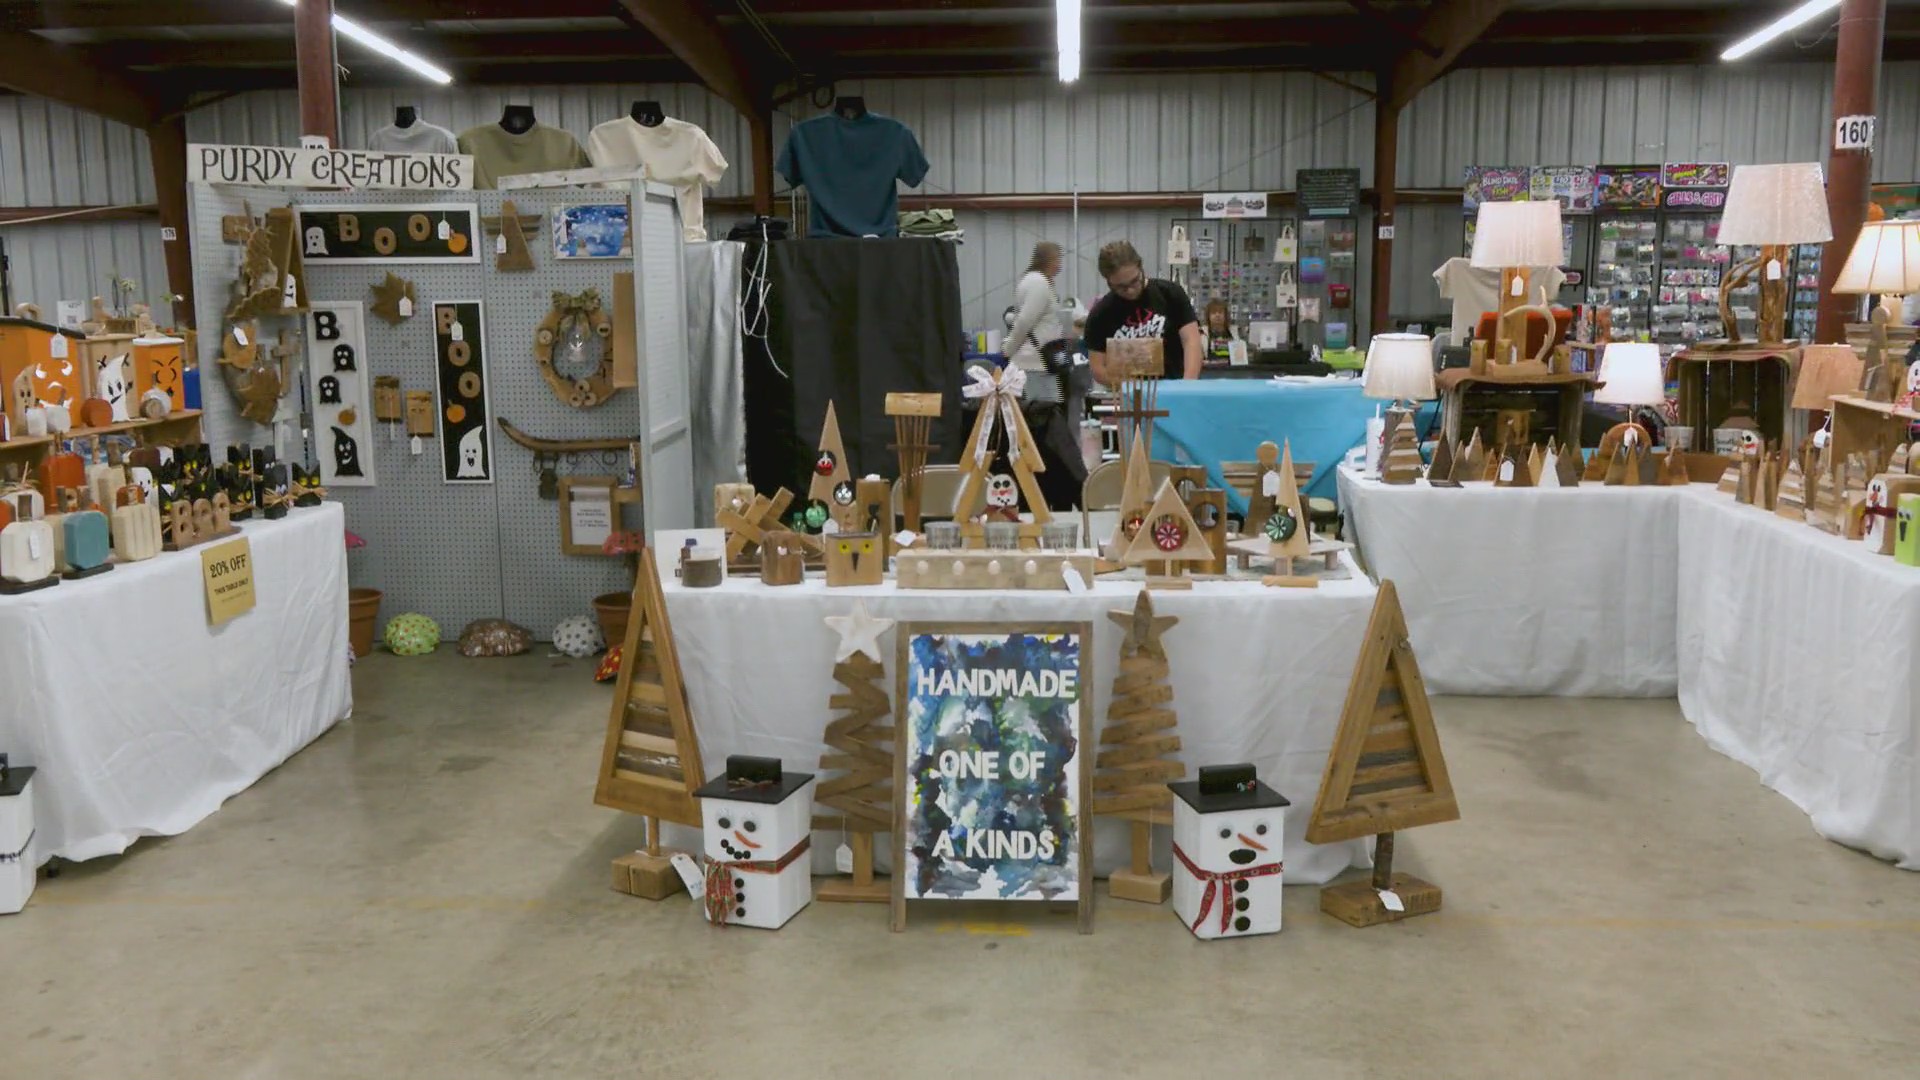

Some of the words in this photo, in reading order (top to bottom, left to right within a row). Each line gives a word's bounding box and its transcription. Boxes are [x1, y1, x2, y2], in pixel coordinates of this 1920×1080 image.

[1839, 120, 1869, 144] 160
[201, 148, 296, 184] PURDY
[311, 151, 461, 188] CREATIONS
[209, 560, 229, 578] 20%
[229, 553, 247, 572] OFF
[916, 668, 1078, 699] HANDMADE
[938, 750, 1000, 780] ONE
[1008, 751, 1046, 780] OF
[931, 829, 955, 858] A
[965, 828, 1056, 860] KINDS
